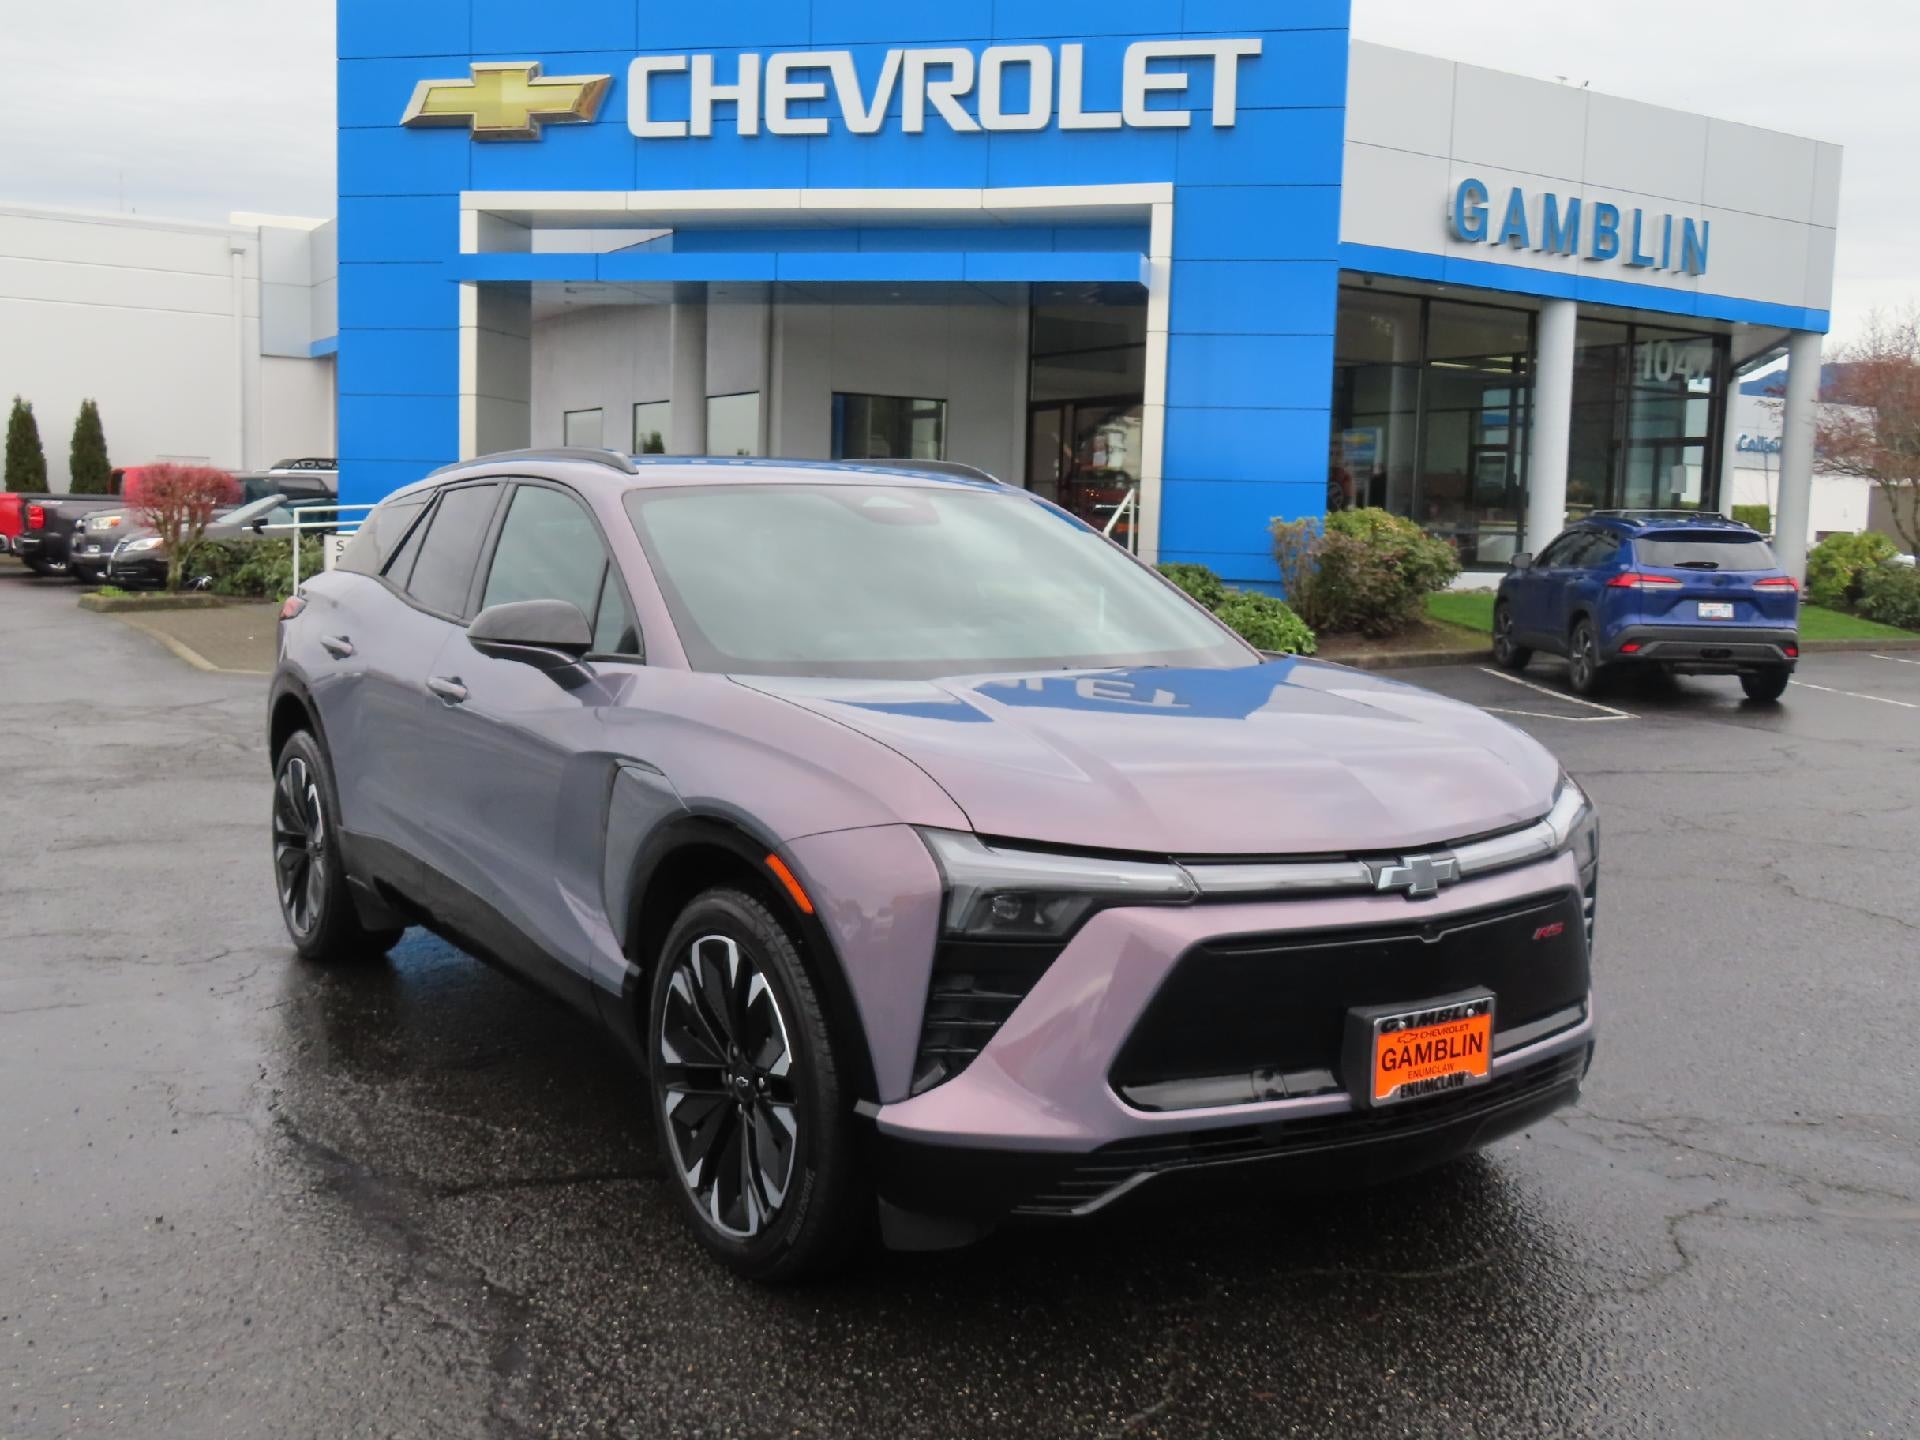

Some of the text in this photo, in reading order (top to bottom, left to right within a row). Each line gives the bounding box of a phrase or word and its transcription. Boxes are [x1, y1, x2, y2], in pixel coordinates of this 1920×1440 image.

[628, 38, 1263, 138] CHEVROLET
[1449, 177, 1710, 277] GAMBLIN
[1420, 1023, 1470, 1039] CHEVROLET
[1381, 1031, 1483, 1072] GAMBLIN
[1400, 1071, 1466, 1098] ENUMCLAW
[1407, 1062, 1455, 1079] ENUMCLAW
